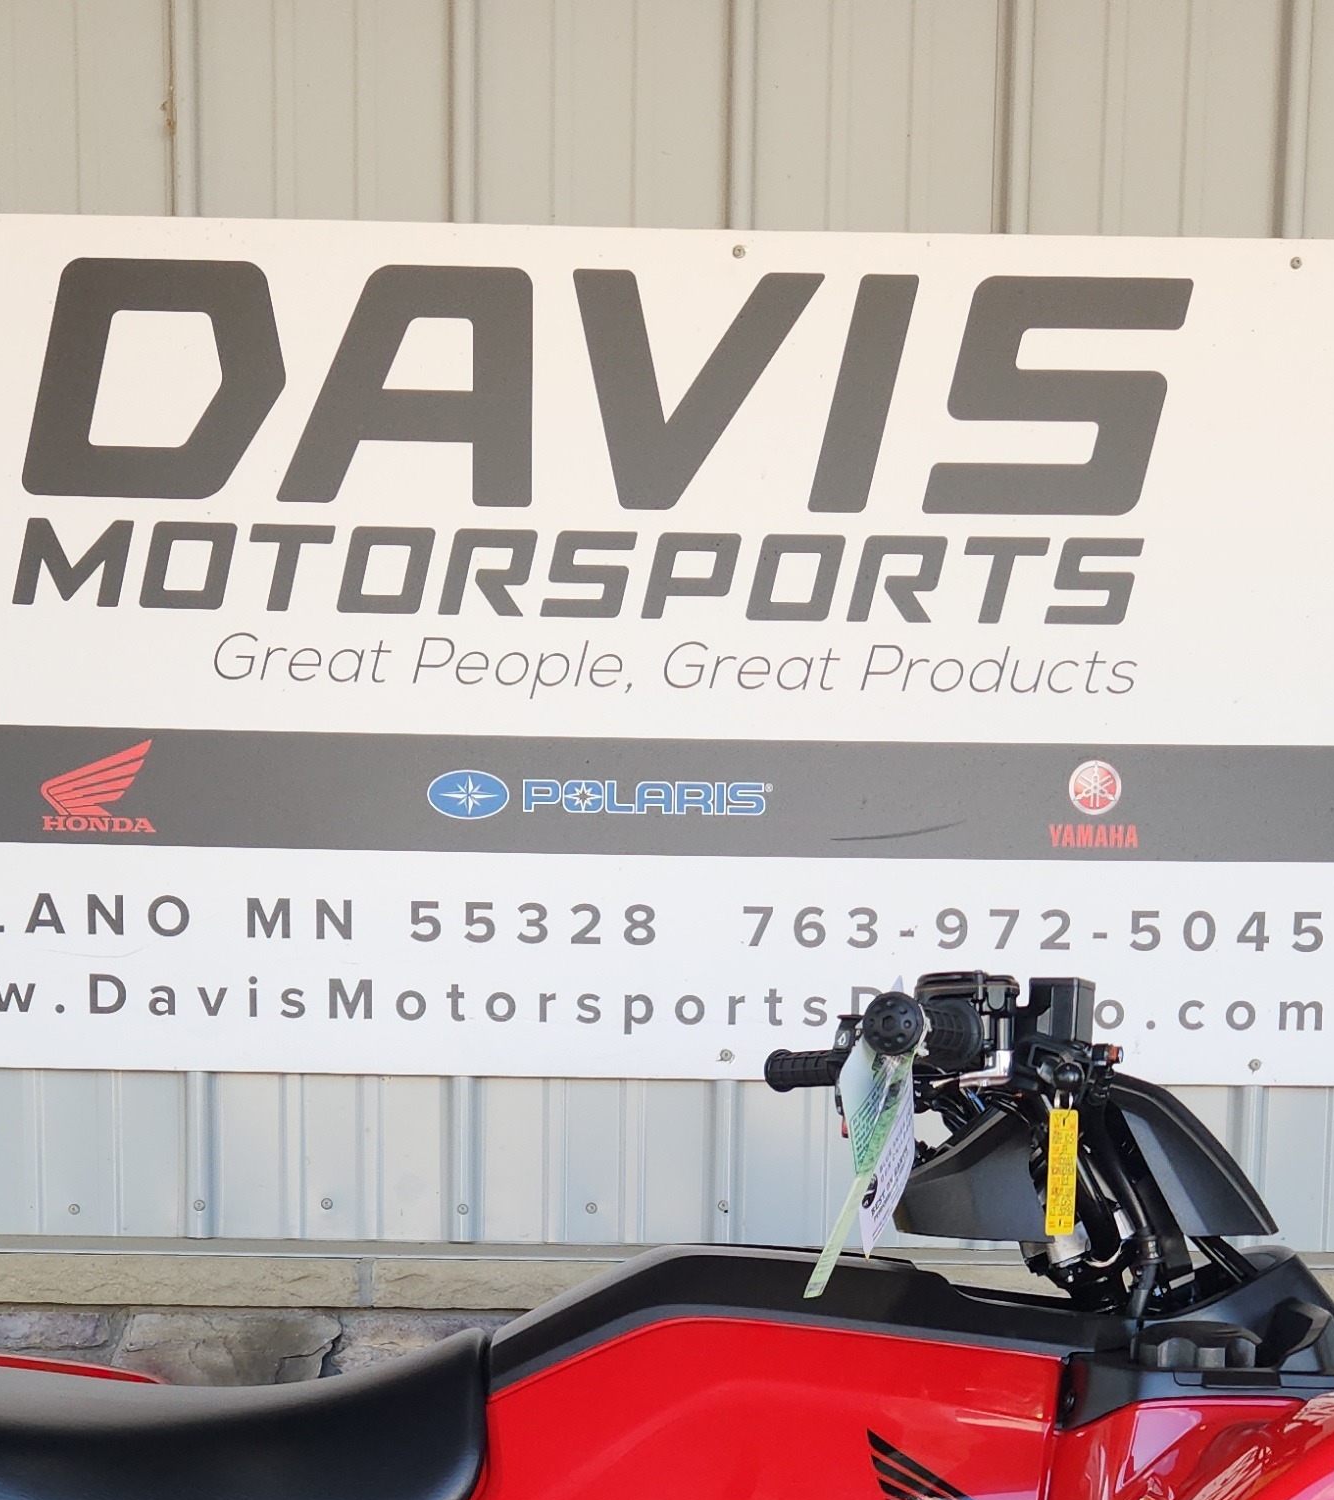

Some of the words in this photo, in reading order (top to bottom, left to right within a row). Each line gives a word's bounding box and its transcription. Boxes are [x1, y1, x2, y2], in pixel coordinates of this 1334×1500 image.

[22, 256, 1195, 516] DAVIS
[12, 517, 1145, 626] MOTORSPORTS
[213, 631, 392, 684] Great
[413, 636, 639, 700] People,
[663, 640, 841, 691] Great
[860, 644, 1138, 695] Products
[42, 815, 156, 833] HONDA
[1049, 824, 1139, 848] YAMAHA
[246, 897, 352, 941] MN
[410, 900, 656, 946] 55328
[743, 905, 1324, 953] 763-972-5045
